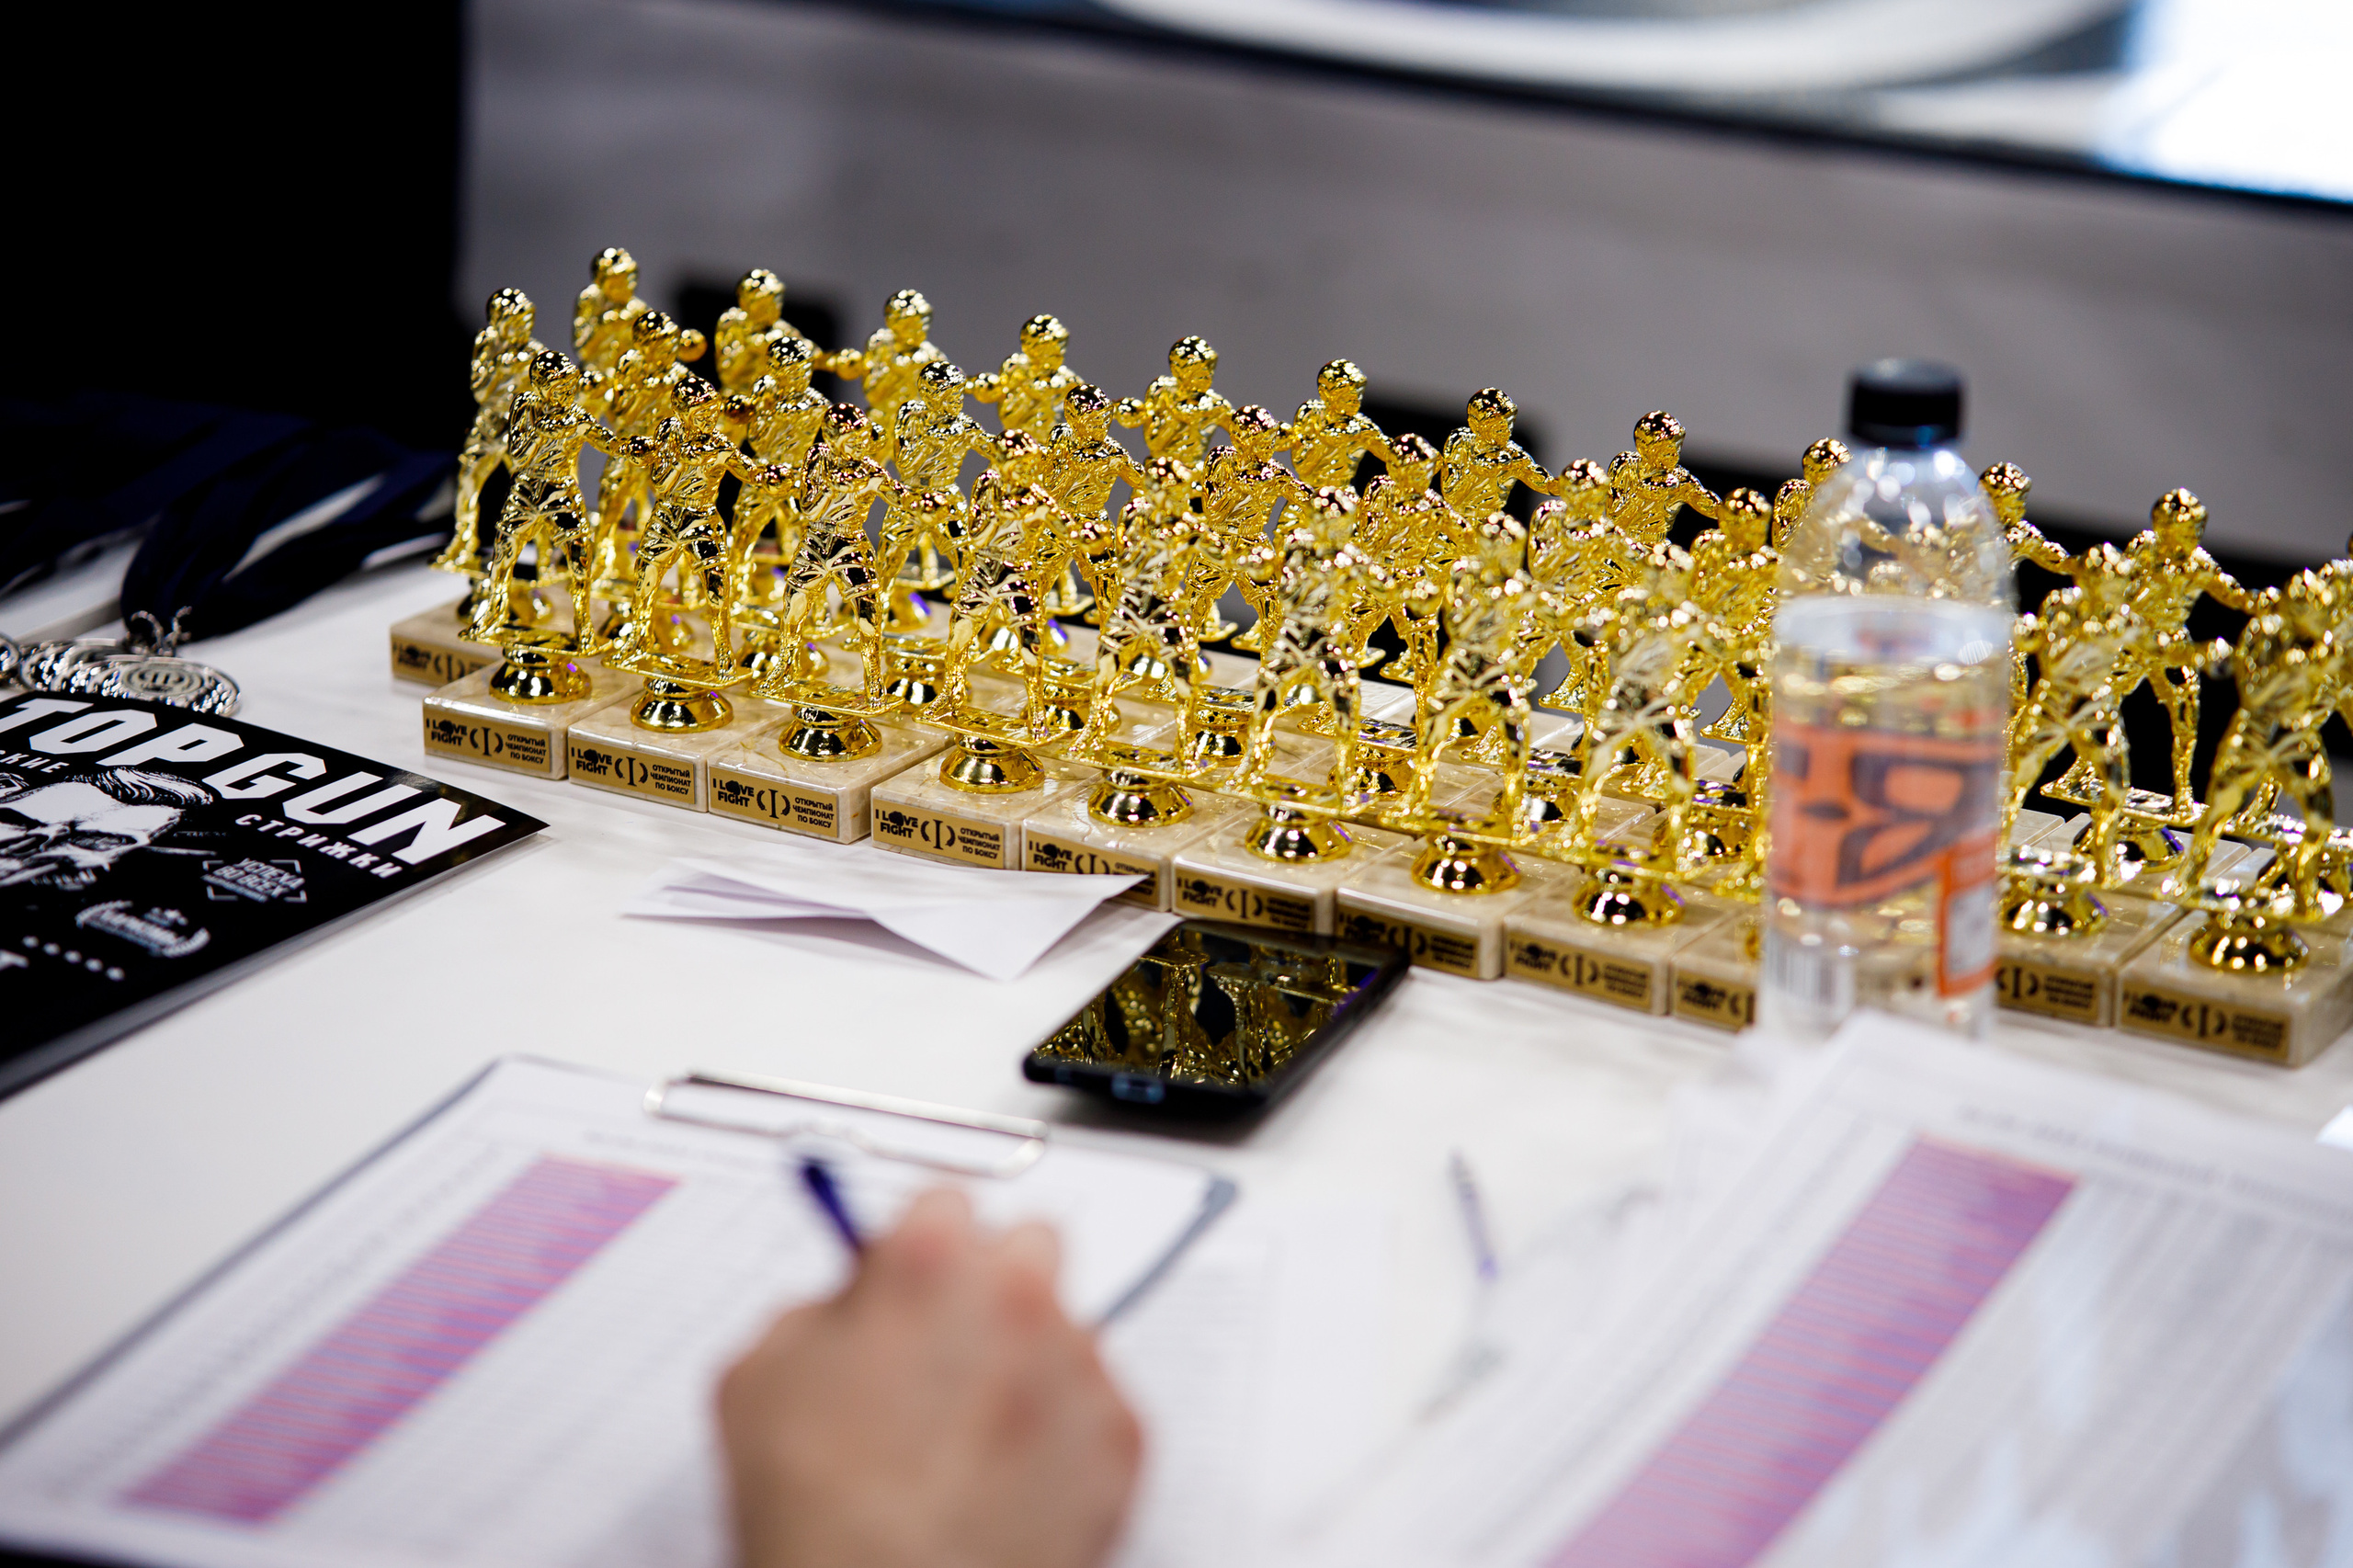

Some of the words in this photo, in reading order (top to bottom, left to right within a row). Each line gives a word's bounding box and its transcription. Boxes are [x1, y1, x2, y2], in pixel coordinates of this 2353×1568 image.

[426, 718, 430, 728] I
[431, 731, 463, 746] FIGHT
[507, 733, 546, 747] ОТКРЫТЫЙ
[505, 741, 547, 756] ЧЕМПИОНАТ
[571, 747, 574, 756] I
[521, 754, 544, 764] БОКСУ
[575, 760, 608, 775] FIGHT
[652, 764, 690, 778] ОТКРЫТЫЙ
[0, 698, 244, 767] TOP
[201, 753, 506, 865] GUN
[650, 772, 691, 787] ЧЕМПИОНАТ
[712, 778, 717, 788] I
[654, 782, 665, 790] ПО
[666, 784, 689, 795] БОКСУ
[718, 790, 750, 807] FIGHT
[794, 797, 834, 812] ОТКРЫТЫЙ
[792, 804, 835, 820] ЧЕМПИОНАТ
[875, 809, 880, 819] I
[797, 814, 808, 823] ПО
[809, 816, 832, 828] БОКСУ
[881, 822, 914, 838] FIGHT
[235, 814, 403, 878] СТРИЖКИ
[962, 845, 973, 854] ПО
[1029, 840, 1033, 850] I
[1033, 853, 1068, 871] FIGHT
